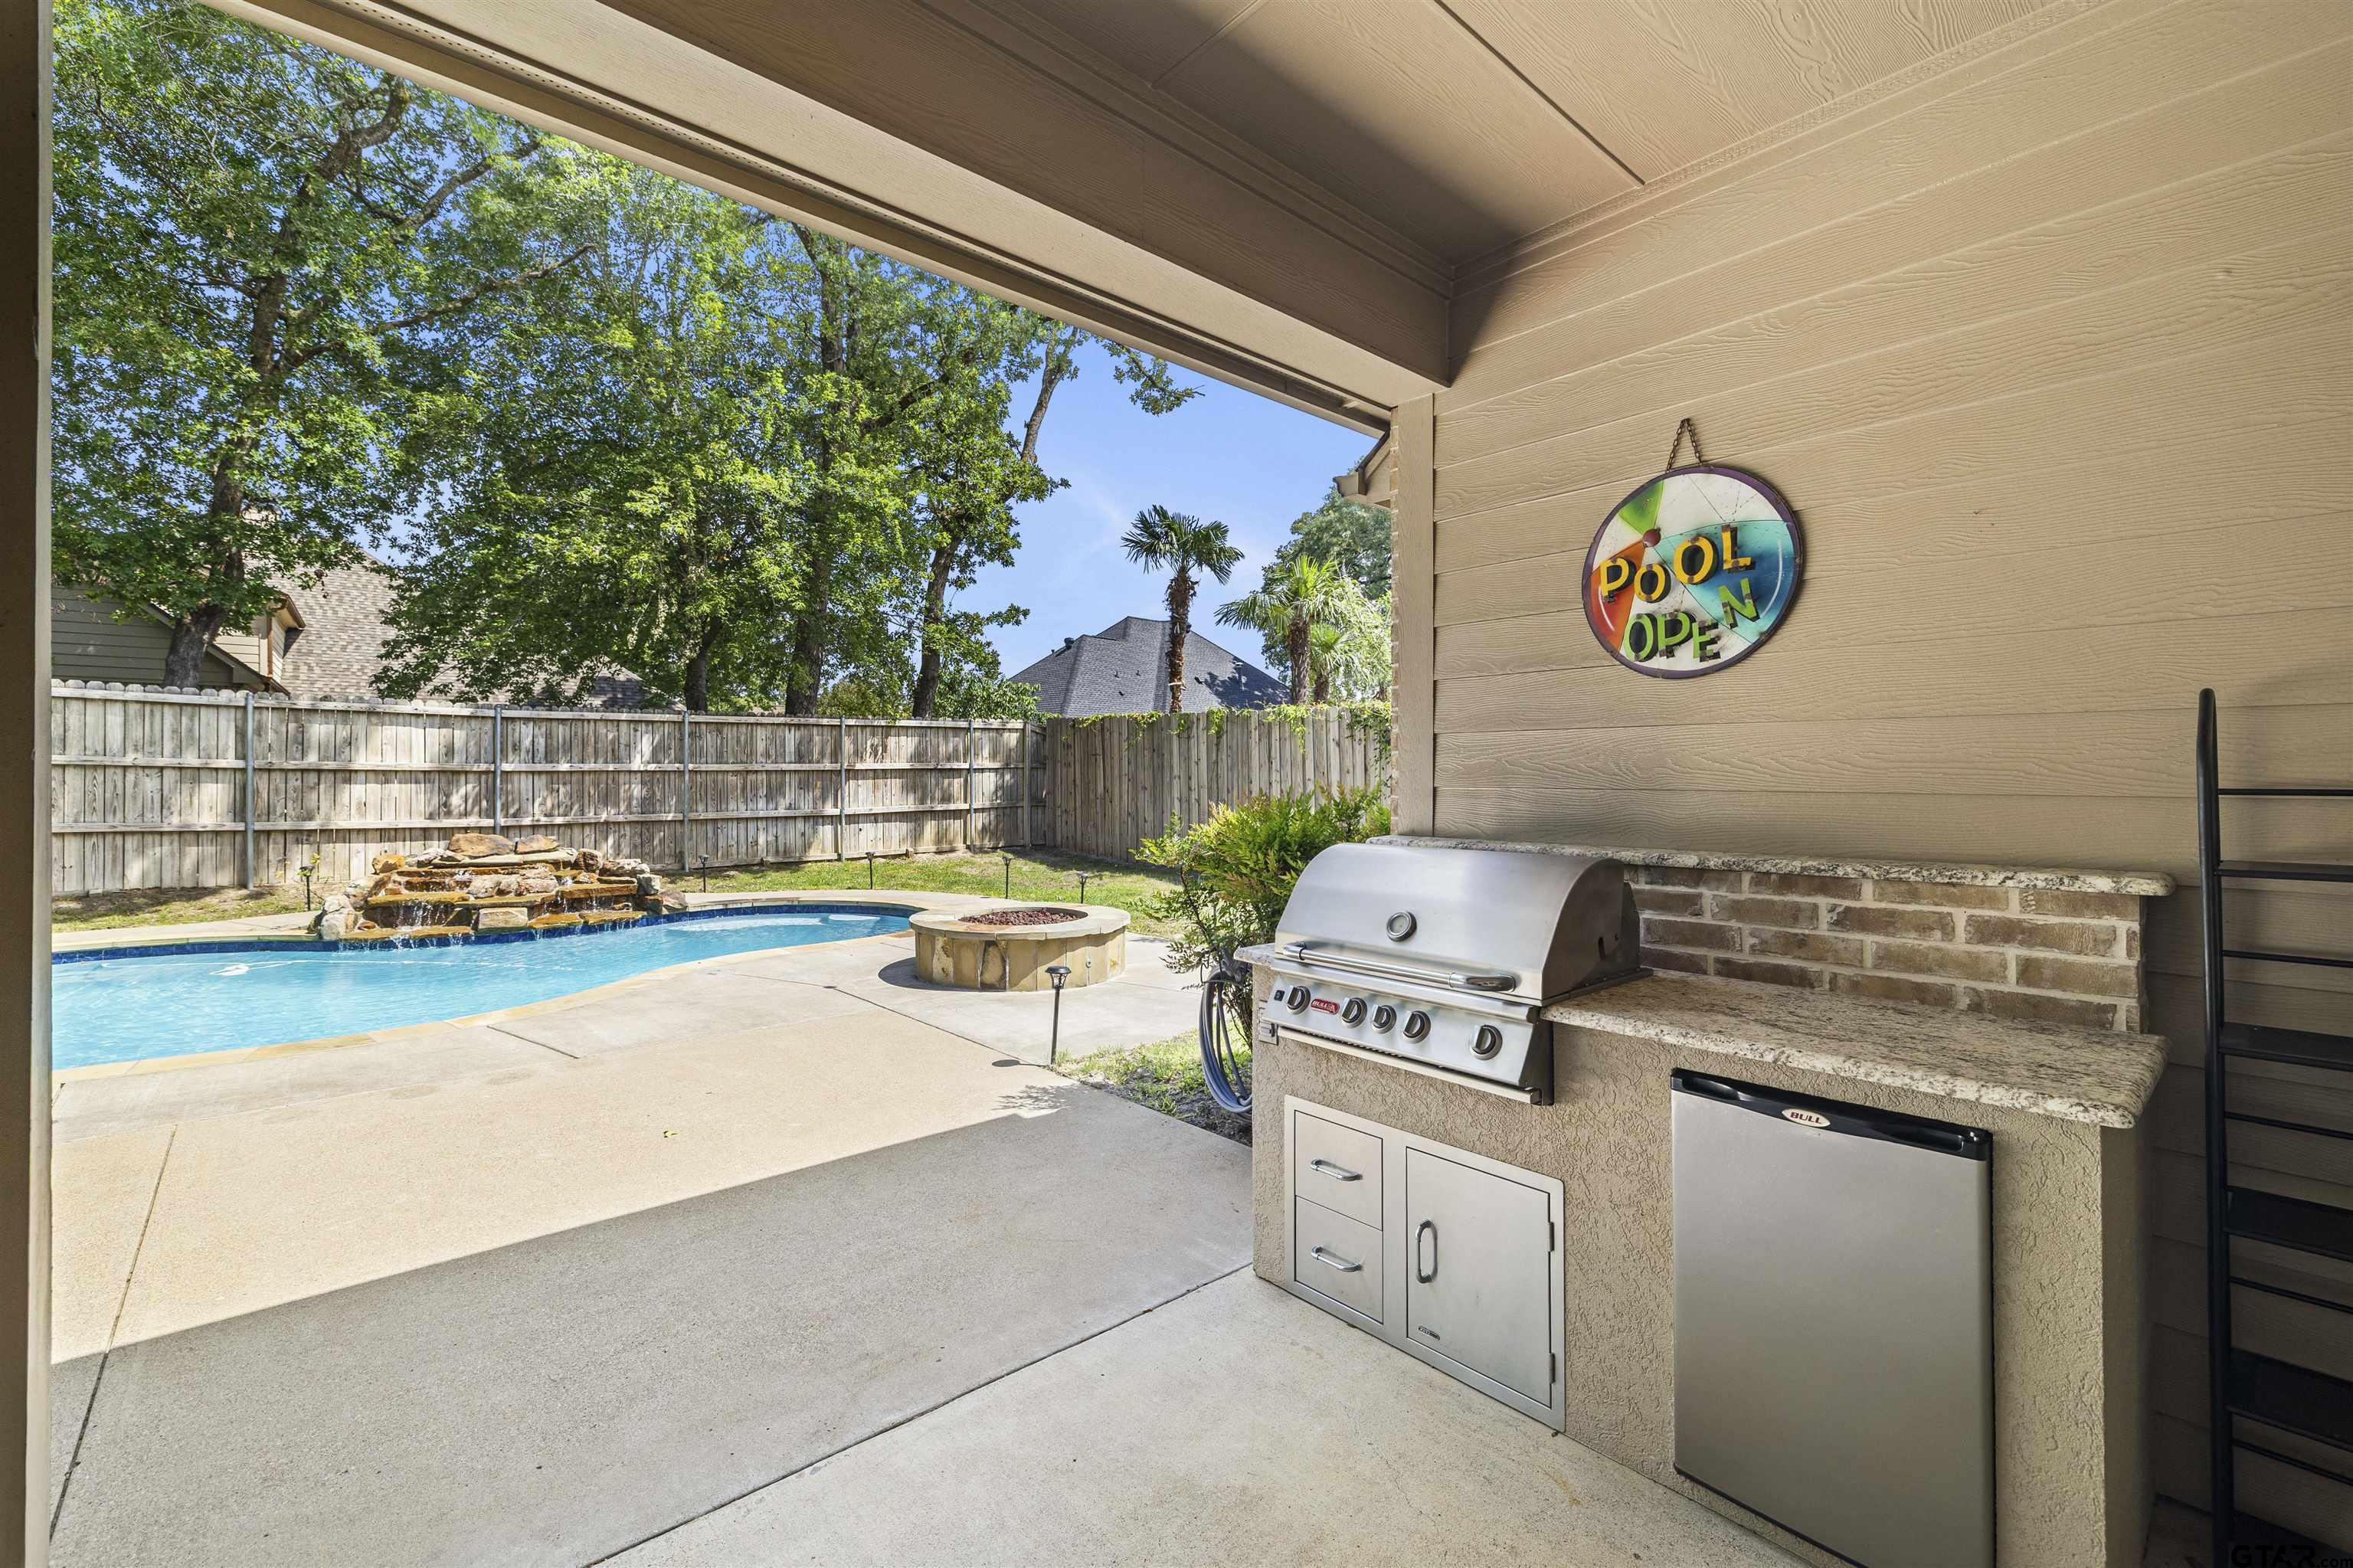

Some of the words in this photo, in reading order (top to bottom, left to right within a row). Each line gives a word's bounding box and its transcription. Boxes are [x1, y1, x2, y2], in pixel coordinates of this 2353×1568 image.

[1599, 525, 1753, 603] POOL
[1623, 578, 1759, 662] OPEN
[1790, 1111, 1821, 1124] BULL
